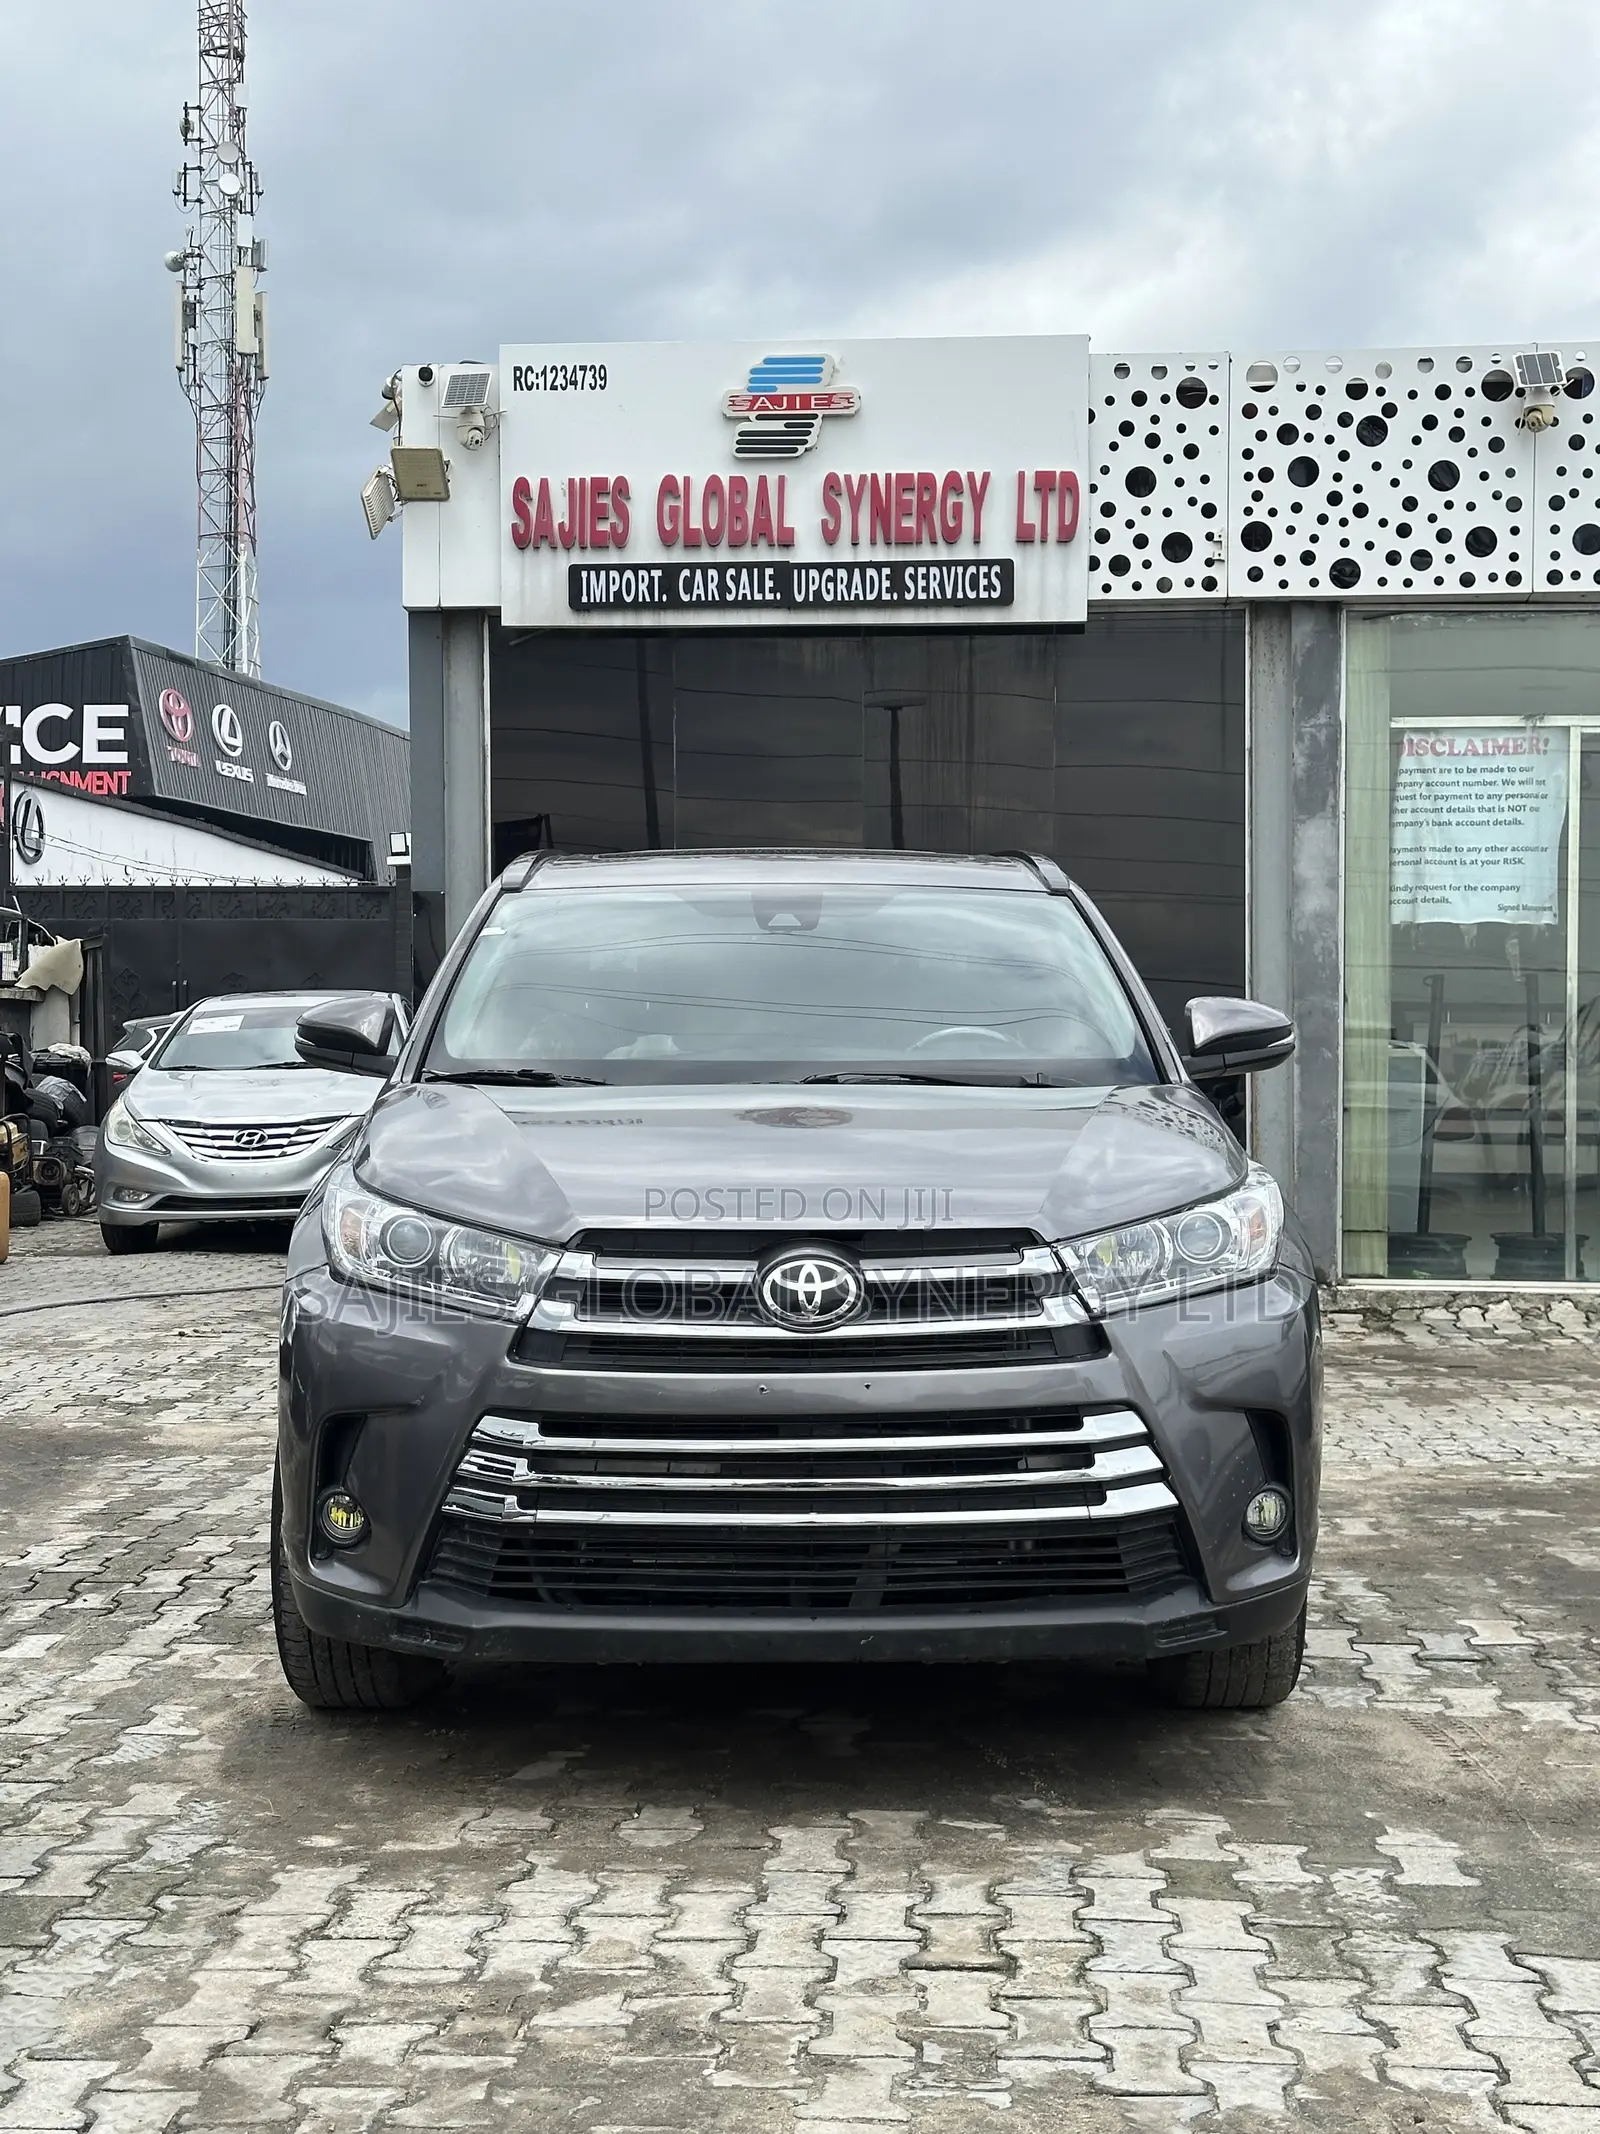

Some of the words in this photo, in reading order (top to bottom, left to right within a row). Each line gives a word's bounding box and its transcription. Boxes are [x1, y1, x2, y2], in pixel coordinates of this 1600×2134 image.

[513, 364, 608, 391] RC:1234739
[727, 391, 855, 412] SAJIES
[511, 475, 631, 549] SAJIES
[656, 473, 796, 548] GLOBAL
[821, 470, 991, 545] SYNERGY
[1016, 470, 1080, 543] LTD
[580, 569, 668, 603] IMPORT.
[678, 568, 721, 602] CAR
[725, 567, 782, 601] SALE.
[793, 567, 899, 602] UPGRADE.
[904, 564, 1002, 600] SERVICES
[0, 703, 129, 765] ICE
[1398, 737, 1550, 757] ISCLAIMER!
[1467, 765, 1478, 774] be
[1480, 765, 1505, 774] made
[1507, 765, 1517, 773] to
[1426, 780, 1460, 788] account
[1462, 779, 1499, 787] number.
[1502, 778, 1516, 786] We
[1518, 777, 1534, 786] will
[1420, 792, 1432, 800] for
[1434, 793, 1473, 802] payment
[1487, 793, 1503, 802] any
[1411, 806, 1444, 814] account
[1446, 805, 1476, 813] details
[1478, 804, 1496, 813] that
[1498, 804, 1505, 813] is
[1508, 804, 1527, 812] NOT
[1432, 819, 1454, 827] bank
[1455, 819, 1491, 827] account
[1492, 817, 1525, 826] details.
[1429, 844, 1453, 853] made
[1455, 845, 1464, 853] to
[1467, 846, 1482, 854] any
[1485, 844, 1509, 853] other
[1424, 858, 1458, 866] account
[1460, 857, 1467, 866] is
[1469, 858, 1479, 866] at
[1480, 858, 1501, 867] your
[1415, 884, 1447, 893] request
[1449, 883, 1462, 892] for
[1464, 883, 1479, 892] the
[1480, 885, 1521, 893] company
